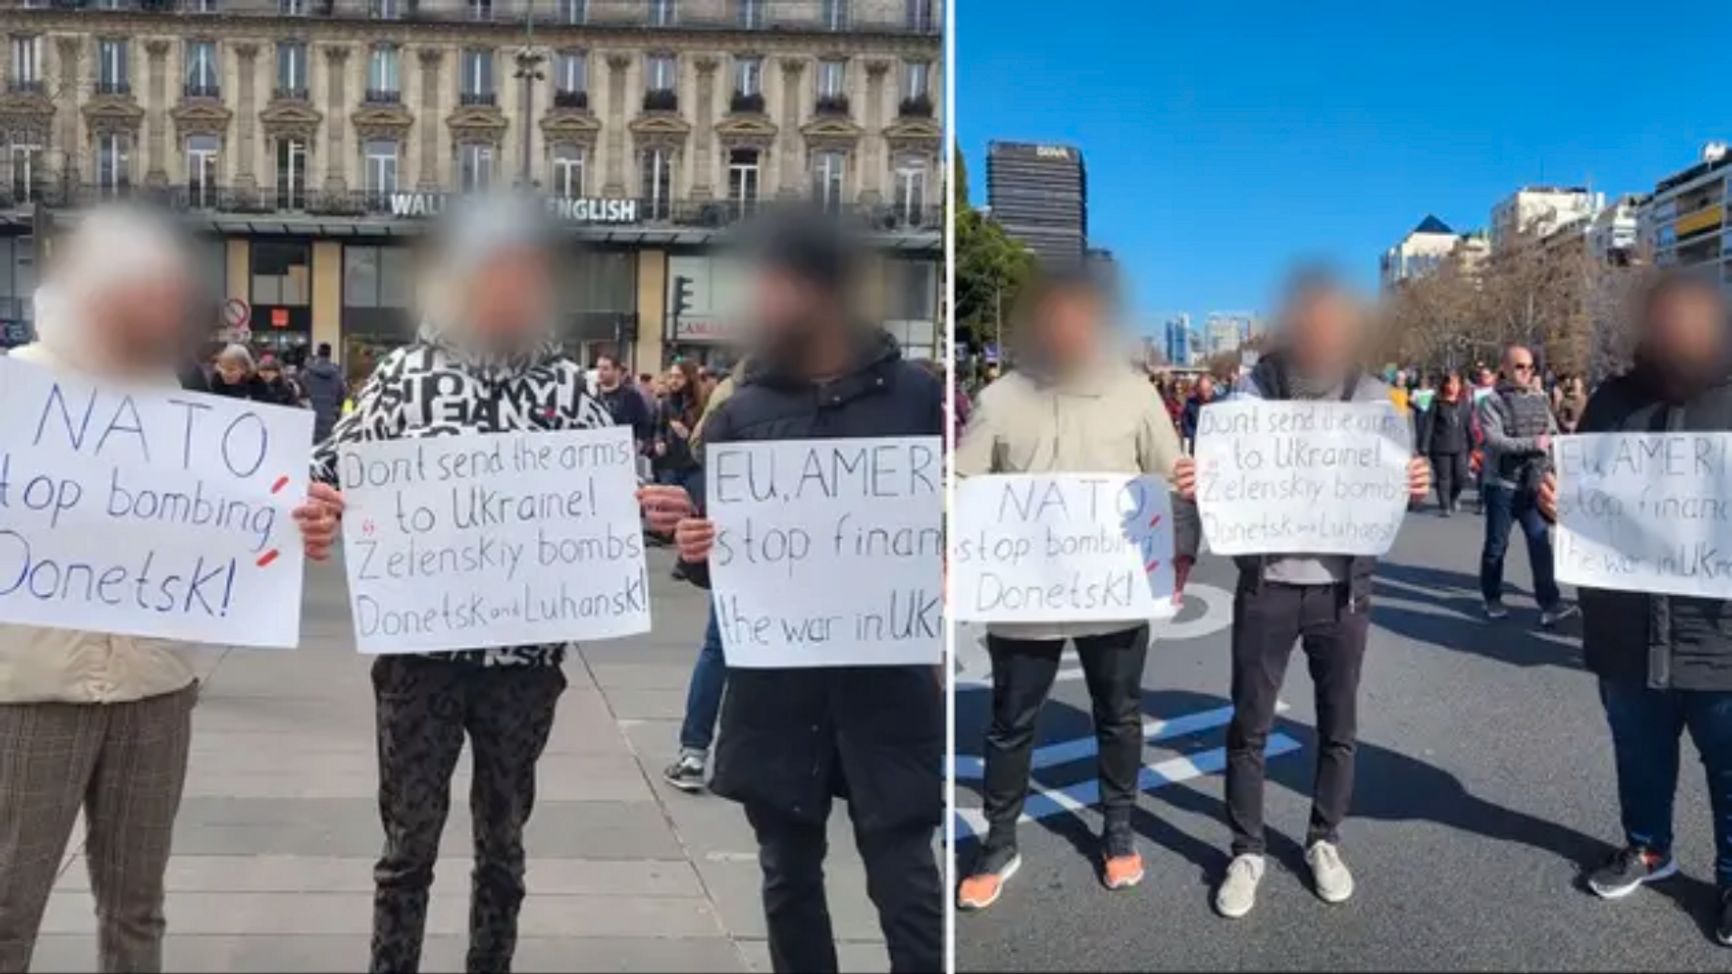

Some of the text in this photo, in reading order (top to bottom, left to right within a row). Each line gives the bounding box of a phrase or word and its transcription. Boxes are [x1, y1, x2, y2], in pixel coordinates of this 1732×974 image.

[33, 383, 269, 478] NATO
[1268, 406, 1315, 433] send
[438, 441, 504, 481] send
[513, 437, 549, 472] the
[559, 439, 631, 470] arms
[1234, 437, 1263, 470] to
[107, 467, 277, 550] bombing
[396, 490, 436, 534] to
[998, 478, 1147, 522] NATO
[355, 523, 642, 581] Zelenskiy bombs
[717, 517, 811, 577] stop
[957, 529, 1030, 565] stop
[356, 567, 647, 637] Donetsk and Luhansk!
[975, 569, 1133, 612] Donetsk!
[719, 593, 771, 645] the
[781, 615, 843, 643] war
[856, 613, 883, 641] in
